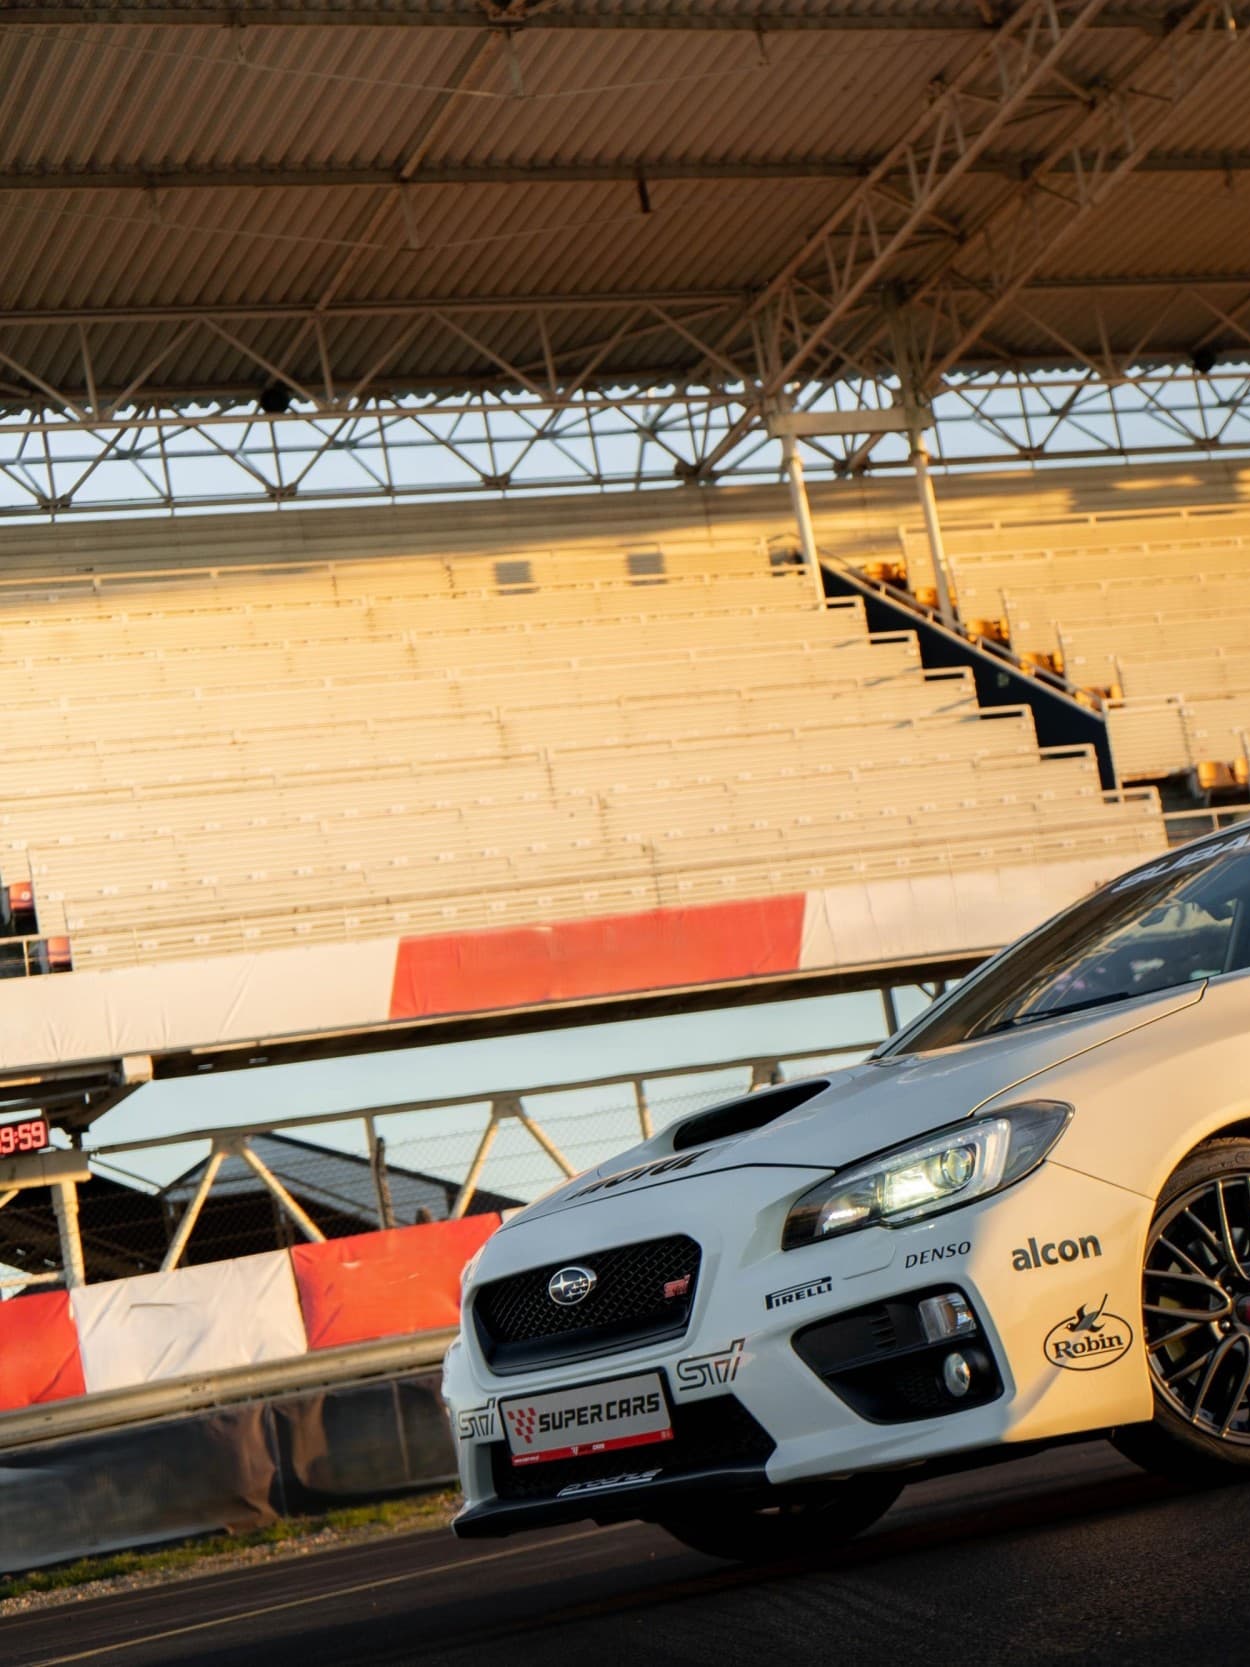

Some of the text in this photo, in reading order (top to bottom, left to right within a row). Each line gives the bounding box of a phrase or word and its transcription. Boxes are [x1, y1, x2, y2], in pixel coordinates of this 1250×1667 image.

[904, 1241, 972, 1269] DENSO
[1011, 1234, 1102, 1272] alcon
[765, 1276, 833, 1310] PIRELLI
[1053, 1329, 1124, 1360] Robin
